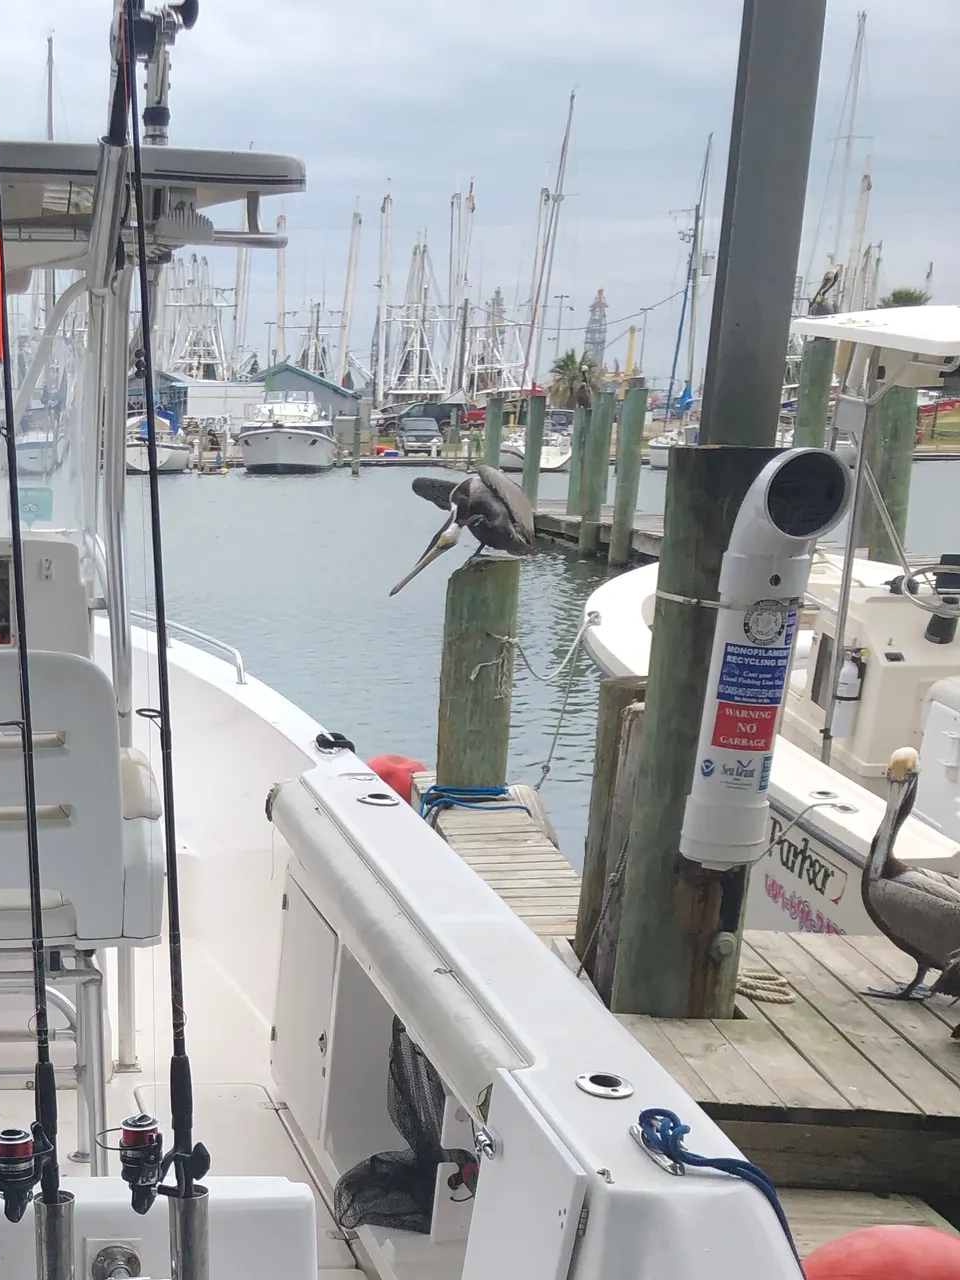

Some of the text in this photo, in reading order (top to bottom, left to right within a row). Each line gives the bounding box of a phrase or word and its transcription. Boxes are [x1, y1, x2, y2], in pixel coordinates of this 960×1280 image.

[726, 655, 776, 667] RECYCLING
[725, 707, 772, 719] WARNING
[736, 722, 757, 734] NO
[720, 735, 767, 747] GARBAGE
[721, 763, 756, 778] Sea Grant
[770, 816, 835, 896] Parker
